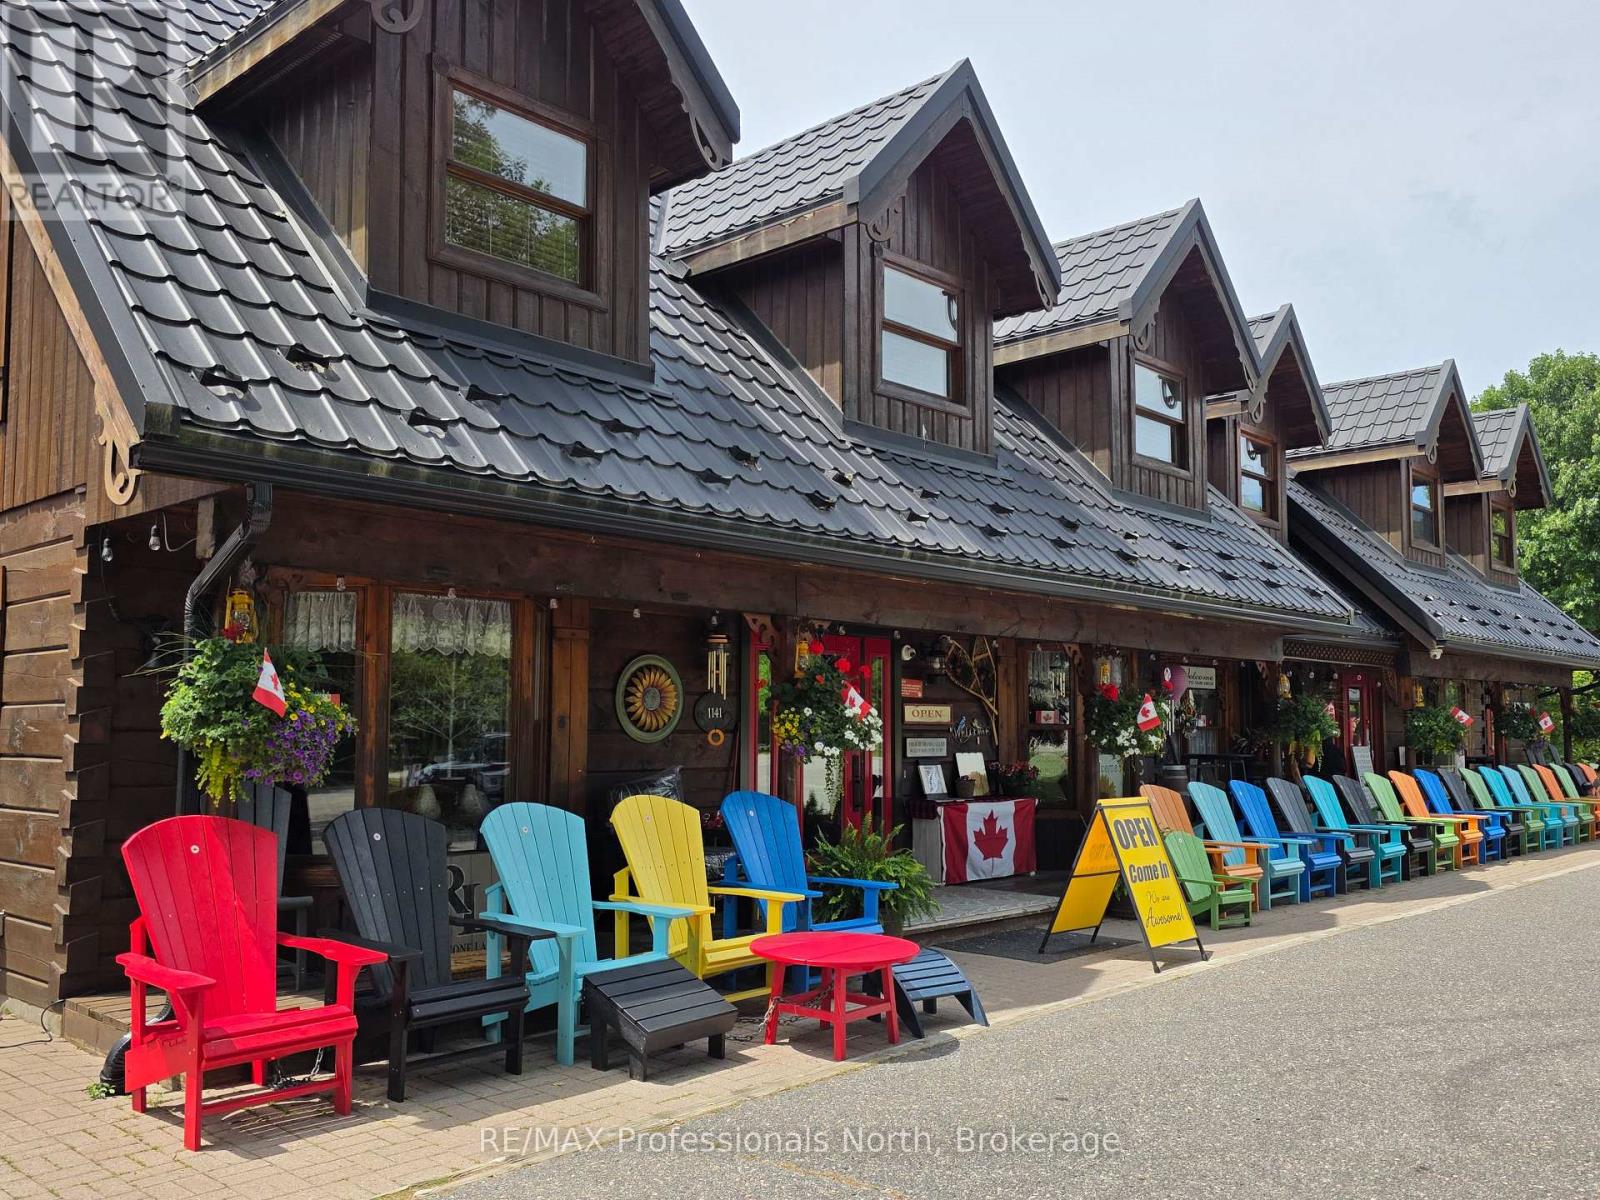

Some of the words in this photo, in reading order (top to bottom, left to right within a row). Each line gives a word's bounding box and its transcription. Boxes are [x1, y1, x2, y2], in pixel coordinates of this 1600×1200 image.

[708, 707, 722, 719] 1141
[911, 709, 943, 718] OPEN
[1113, 817, 1158, 850] OPEN
[1129, 863, 1158, 883] Come
[1160, 860, 1170, 879] In
